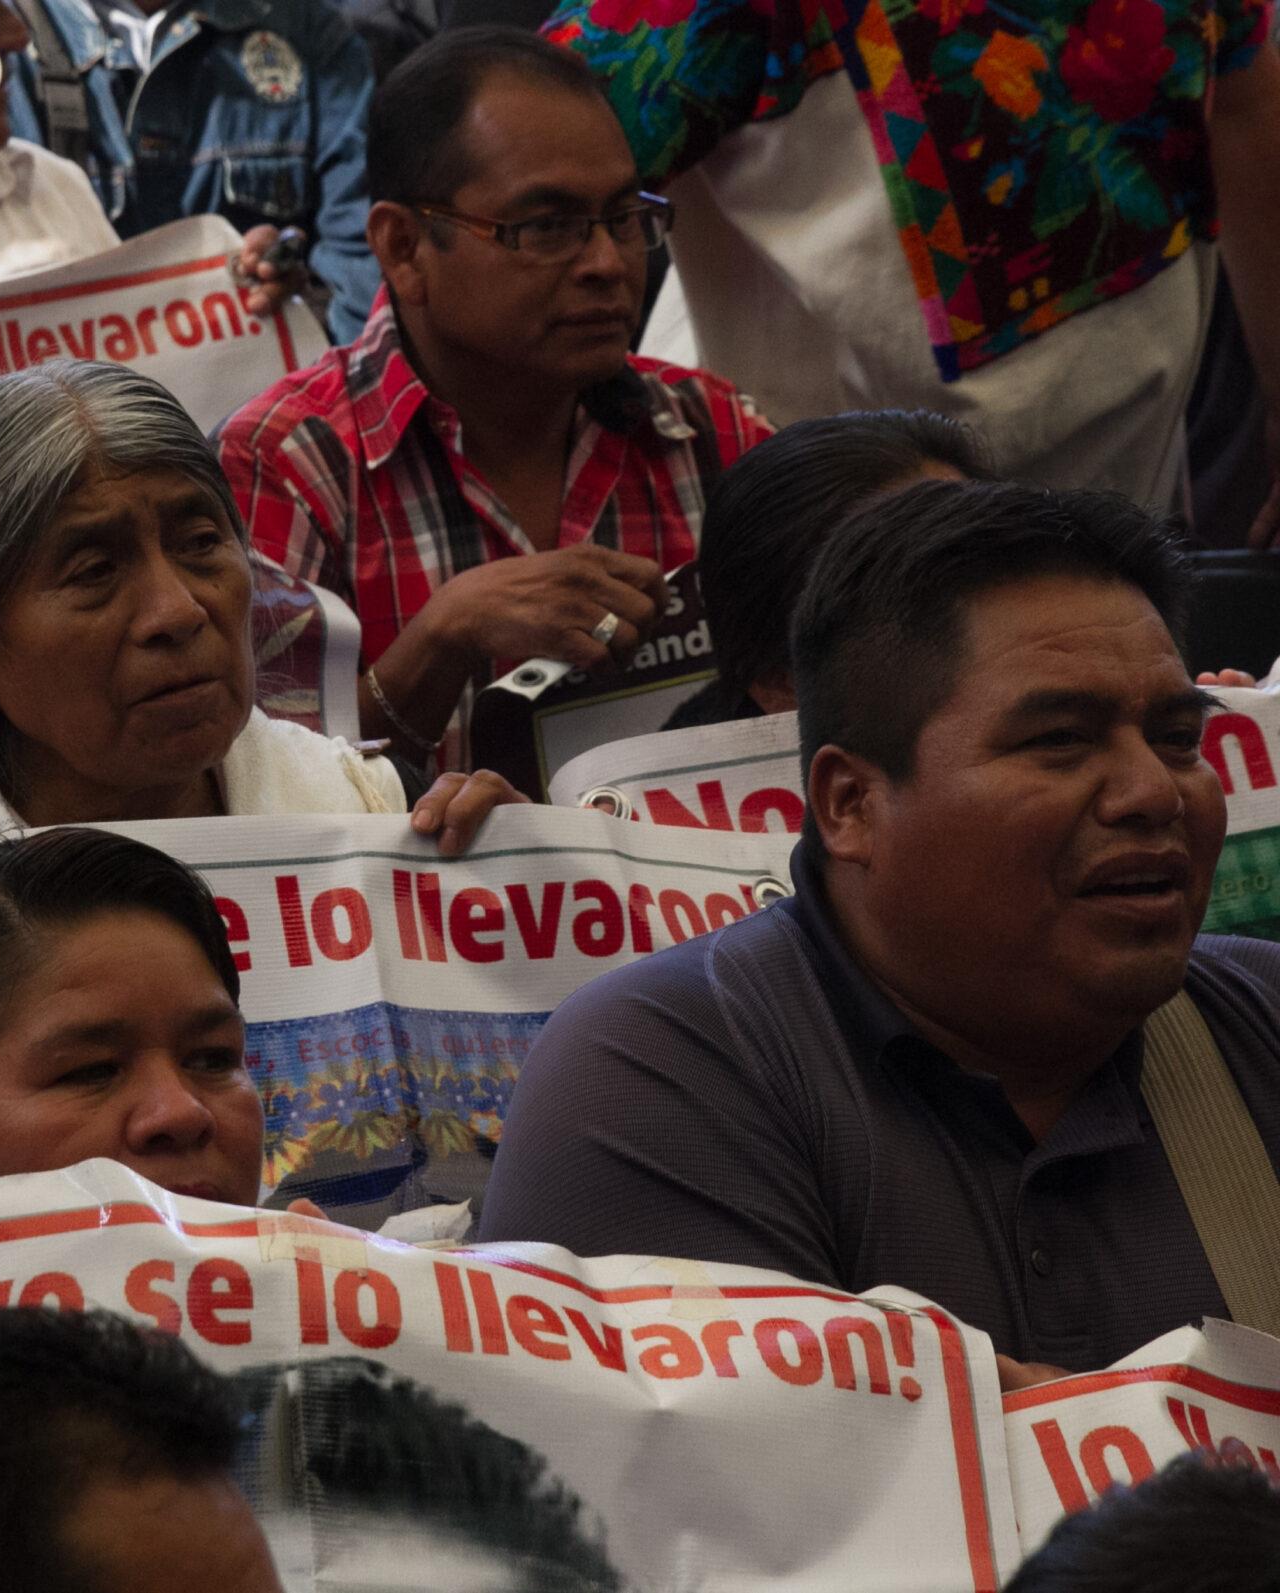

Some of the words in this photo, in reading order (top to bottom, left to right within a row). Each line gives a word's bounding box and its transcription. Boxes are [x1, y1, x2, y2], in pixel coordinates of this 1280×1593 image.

[275, 875, 373, 968] lo
[393, 869, 759, 962] llevaro
[124, 1257, 254, 1345] se
[295, 1246, 402, 1349] lo
[433, 1262, 922, 1402] llevaron!
[1031, 1419, 1155, 1515] lo
